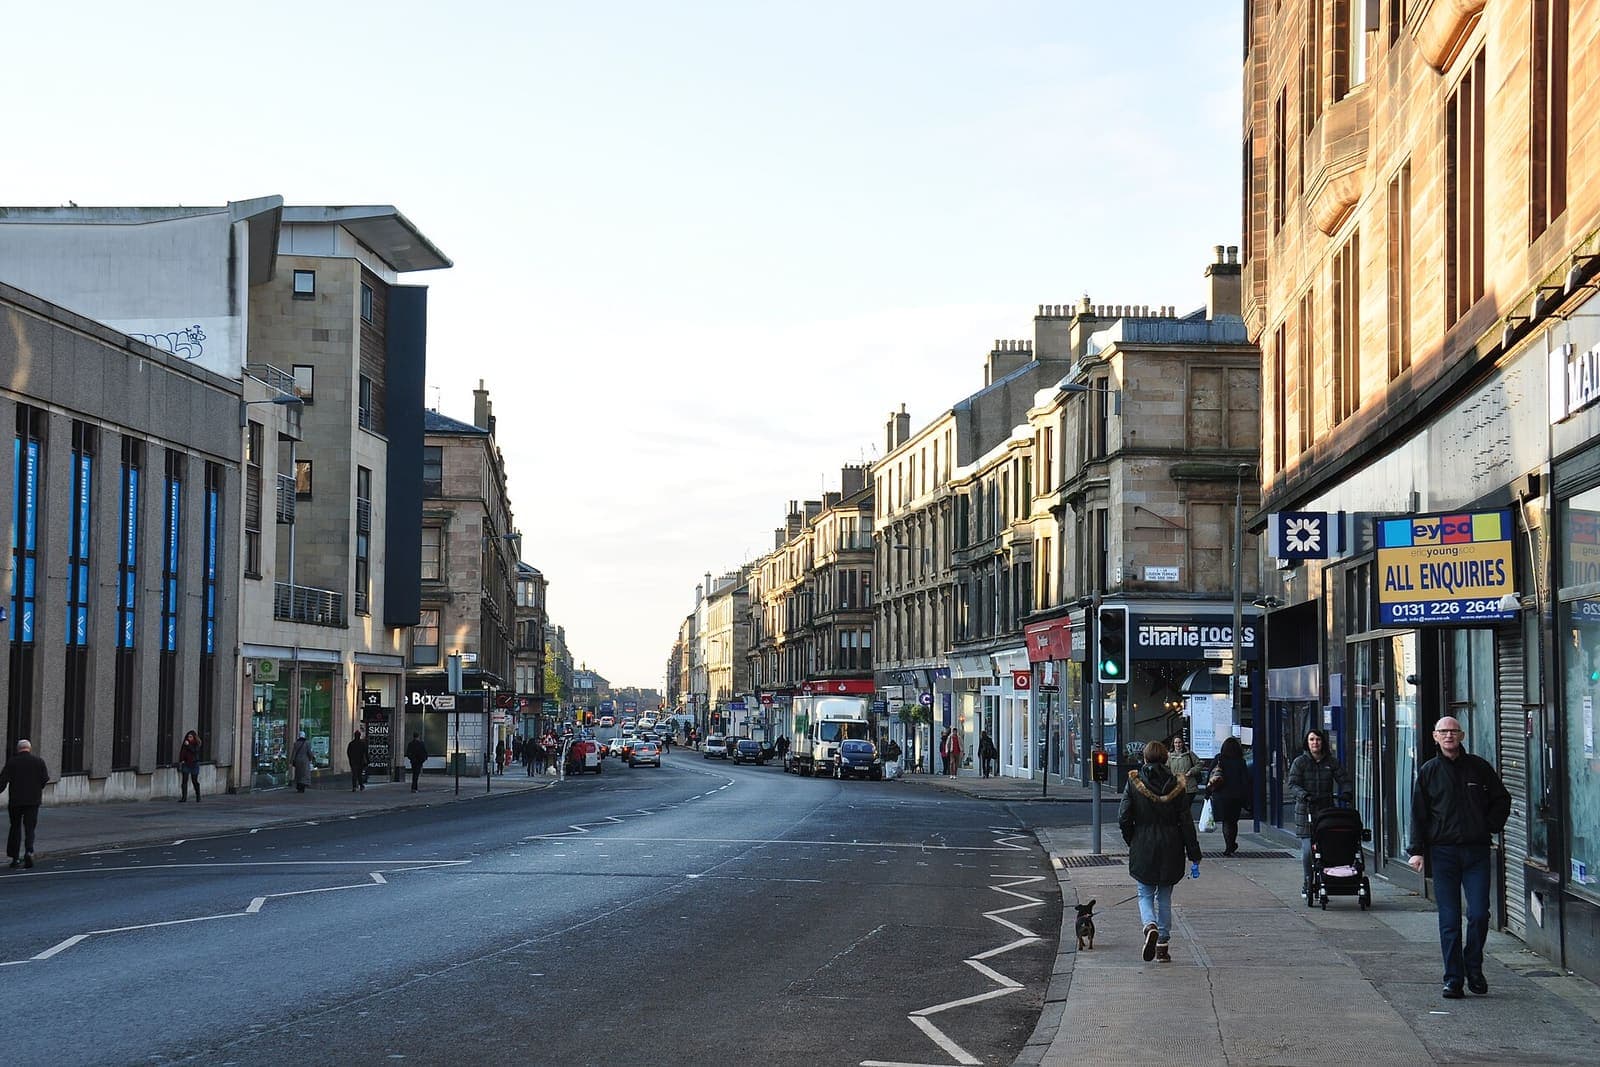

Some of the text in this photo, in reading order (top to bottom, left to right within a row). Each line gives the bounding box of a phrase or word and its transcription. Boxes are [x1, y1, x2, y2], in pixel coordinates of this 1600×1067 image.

[1413, 522, 1472, 539] eyco
[1385, 559, 1506, 594] ALL ENQUIRIES
[1392, 604, 1425, 616] 0131
[1430, 602, 1460, 615] 226
[1138, 626, 1199, 646] charlie
[368, 726, 389, 734] SKIN
